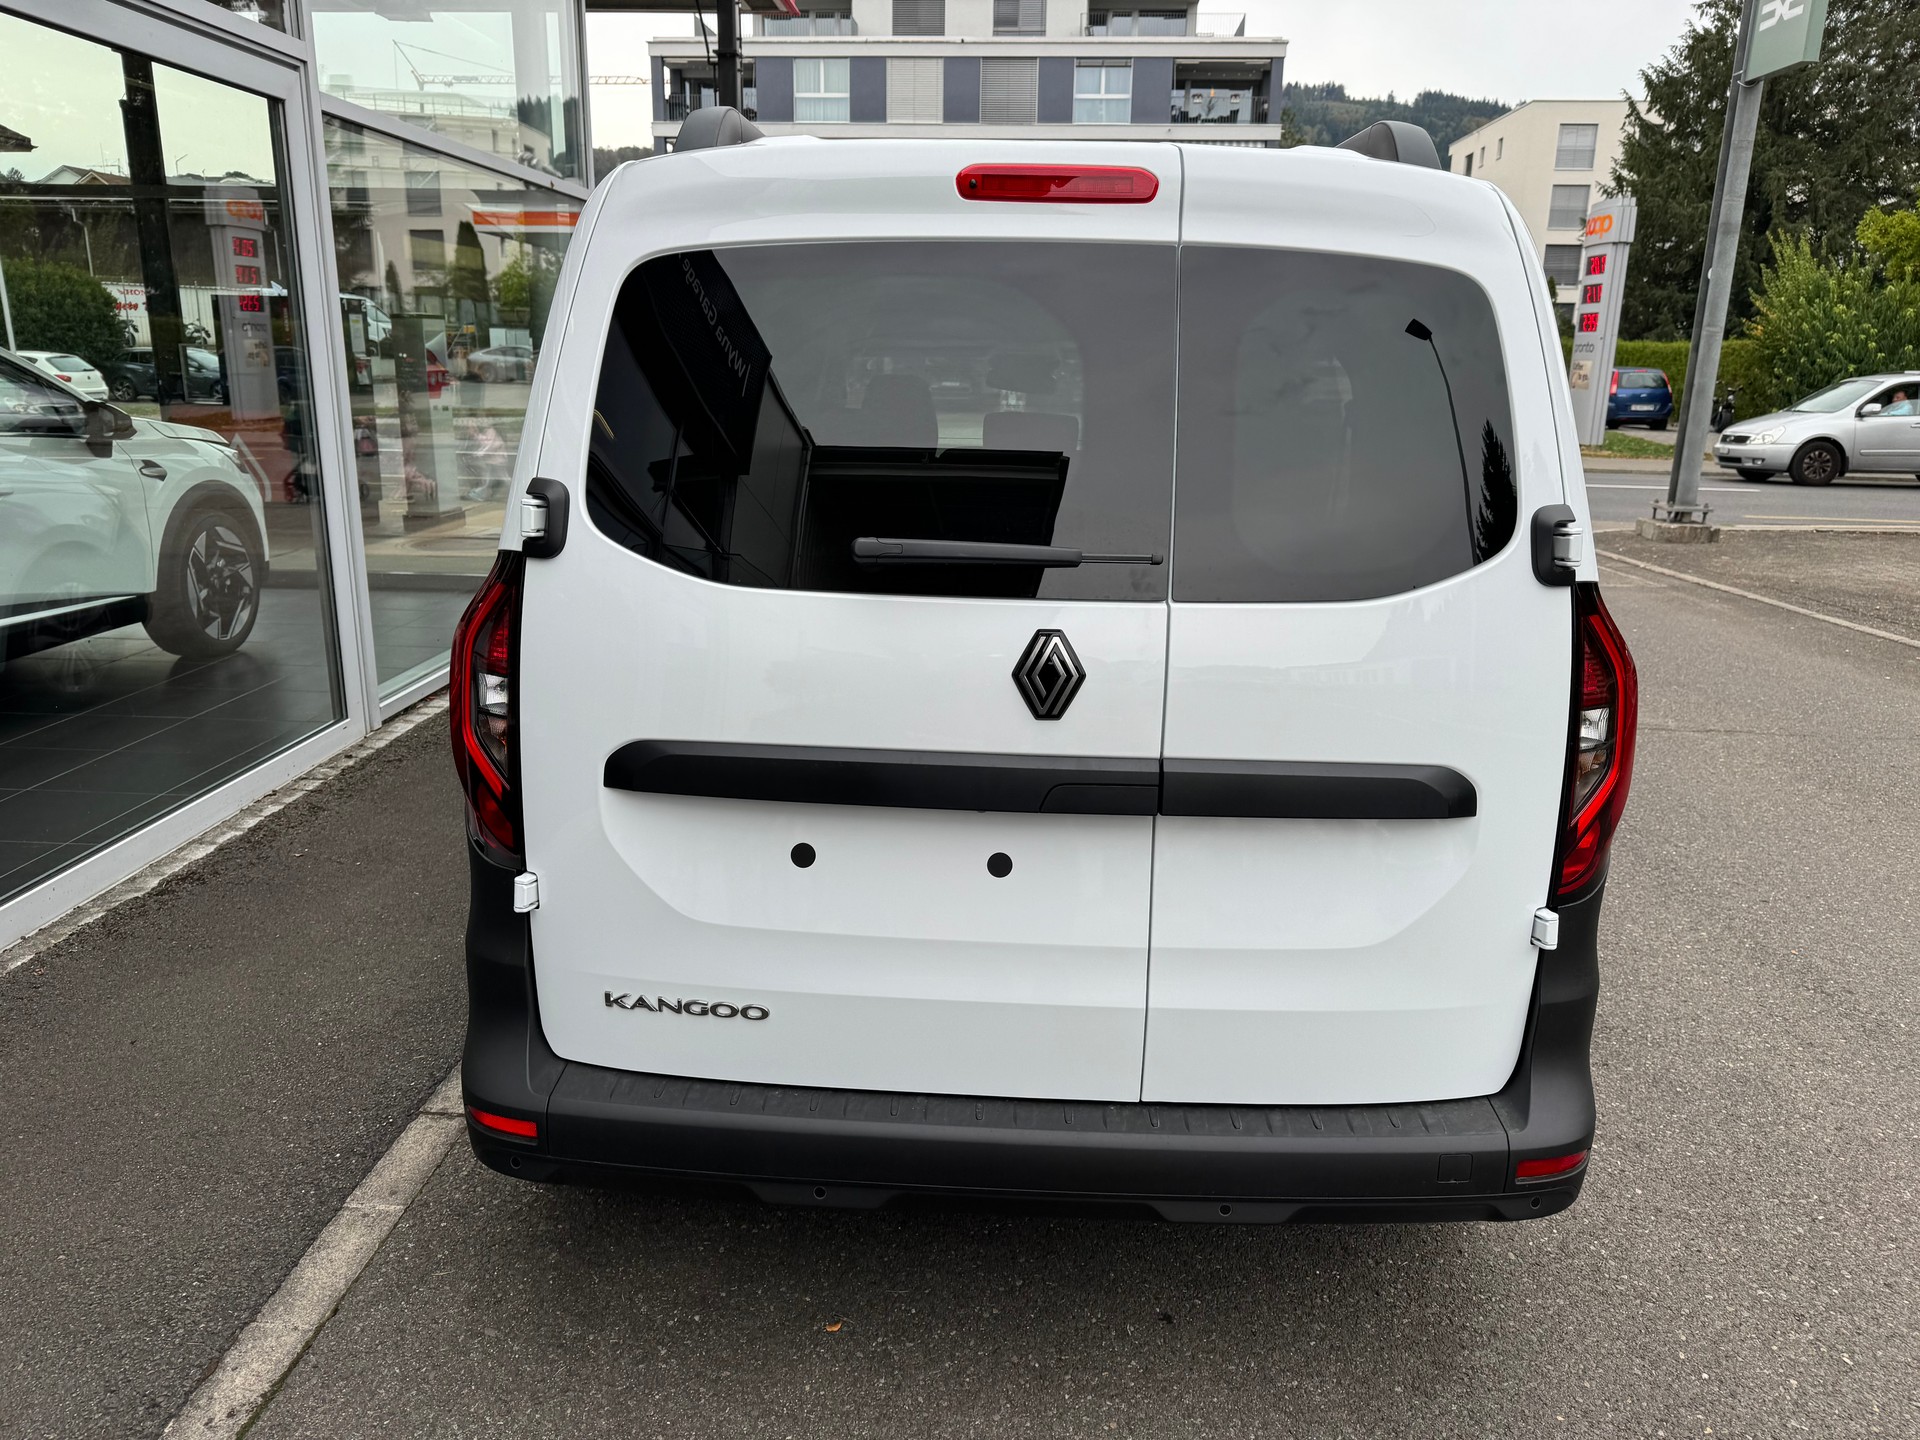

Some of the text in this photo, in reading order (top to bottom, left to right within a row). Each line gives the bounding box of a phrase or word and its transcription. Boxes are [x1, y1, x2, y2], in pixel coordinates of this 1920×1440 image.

[341, 298, 348, 311] 1
[360, 300, 367, 312] 2
[604, 990, 771, 1021] KANGOO
